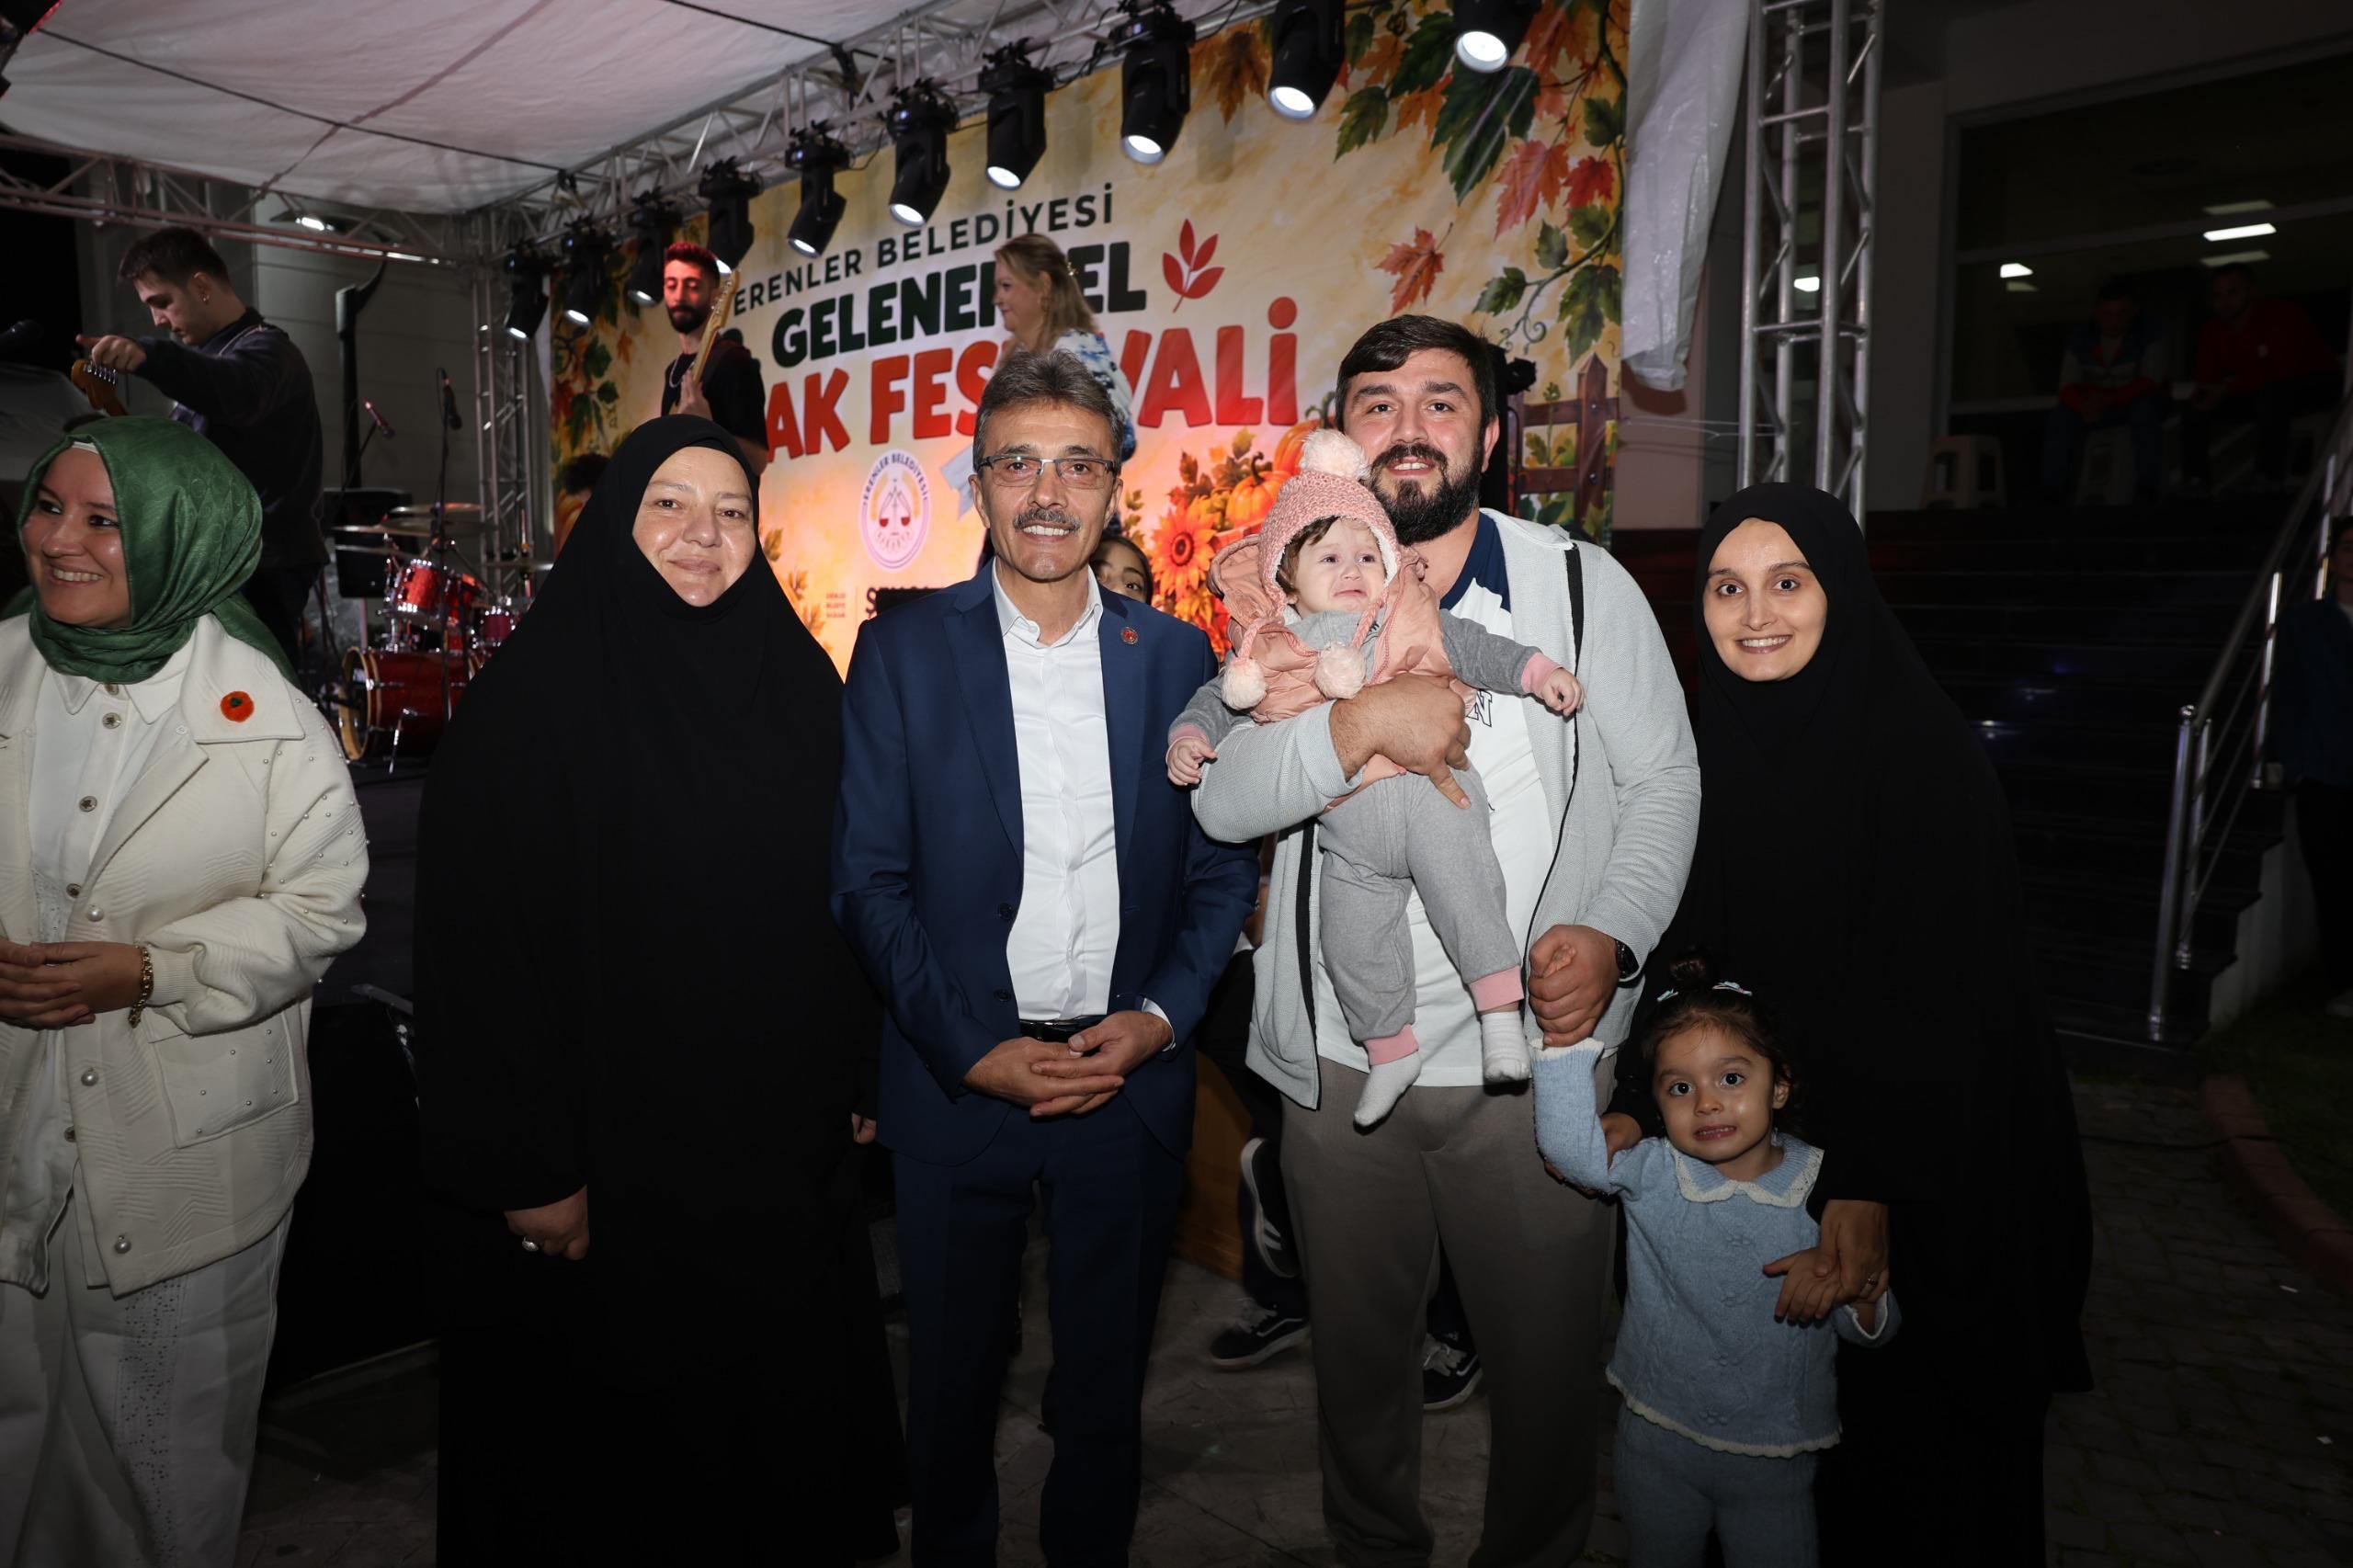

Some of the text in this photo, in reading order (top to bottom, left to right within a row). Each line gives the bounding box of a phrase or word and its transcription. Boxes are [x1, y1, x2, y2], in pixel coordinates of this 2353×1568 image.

[734, 182, 1112, 316] ERENLER BELEDİYESİ
[772, 241, 1147, 368] GELENEEL
